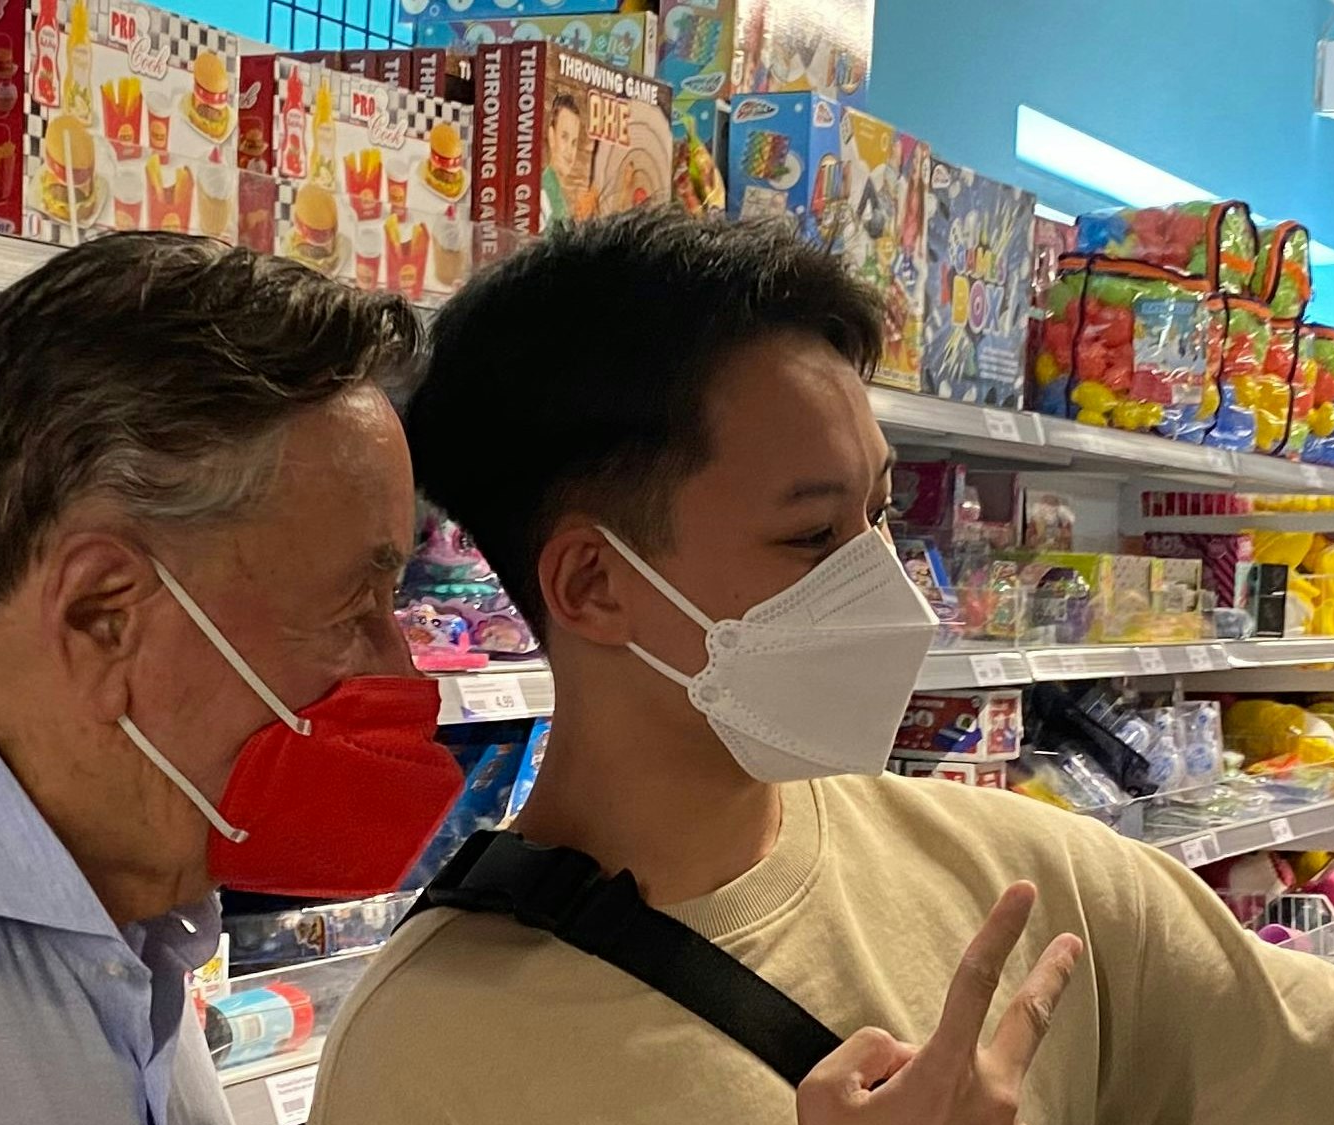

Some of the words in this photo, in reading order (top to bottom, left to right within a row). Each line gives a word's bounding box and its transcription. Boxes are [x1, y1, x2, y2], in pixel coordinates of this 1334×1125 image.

[112, 11, 136, 40] PRO
[353, 93, 376, 116] PRO
[559, 53, 623, 93] THROWING
[625, 77, 659, 106] GAME
[481, 49, 501, 180] THROWING
[515, 46, 537, 178] THROWING
[480, 187, 498, 255] GAME
[514, 184, 532, 237] GAM
